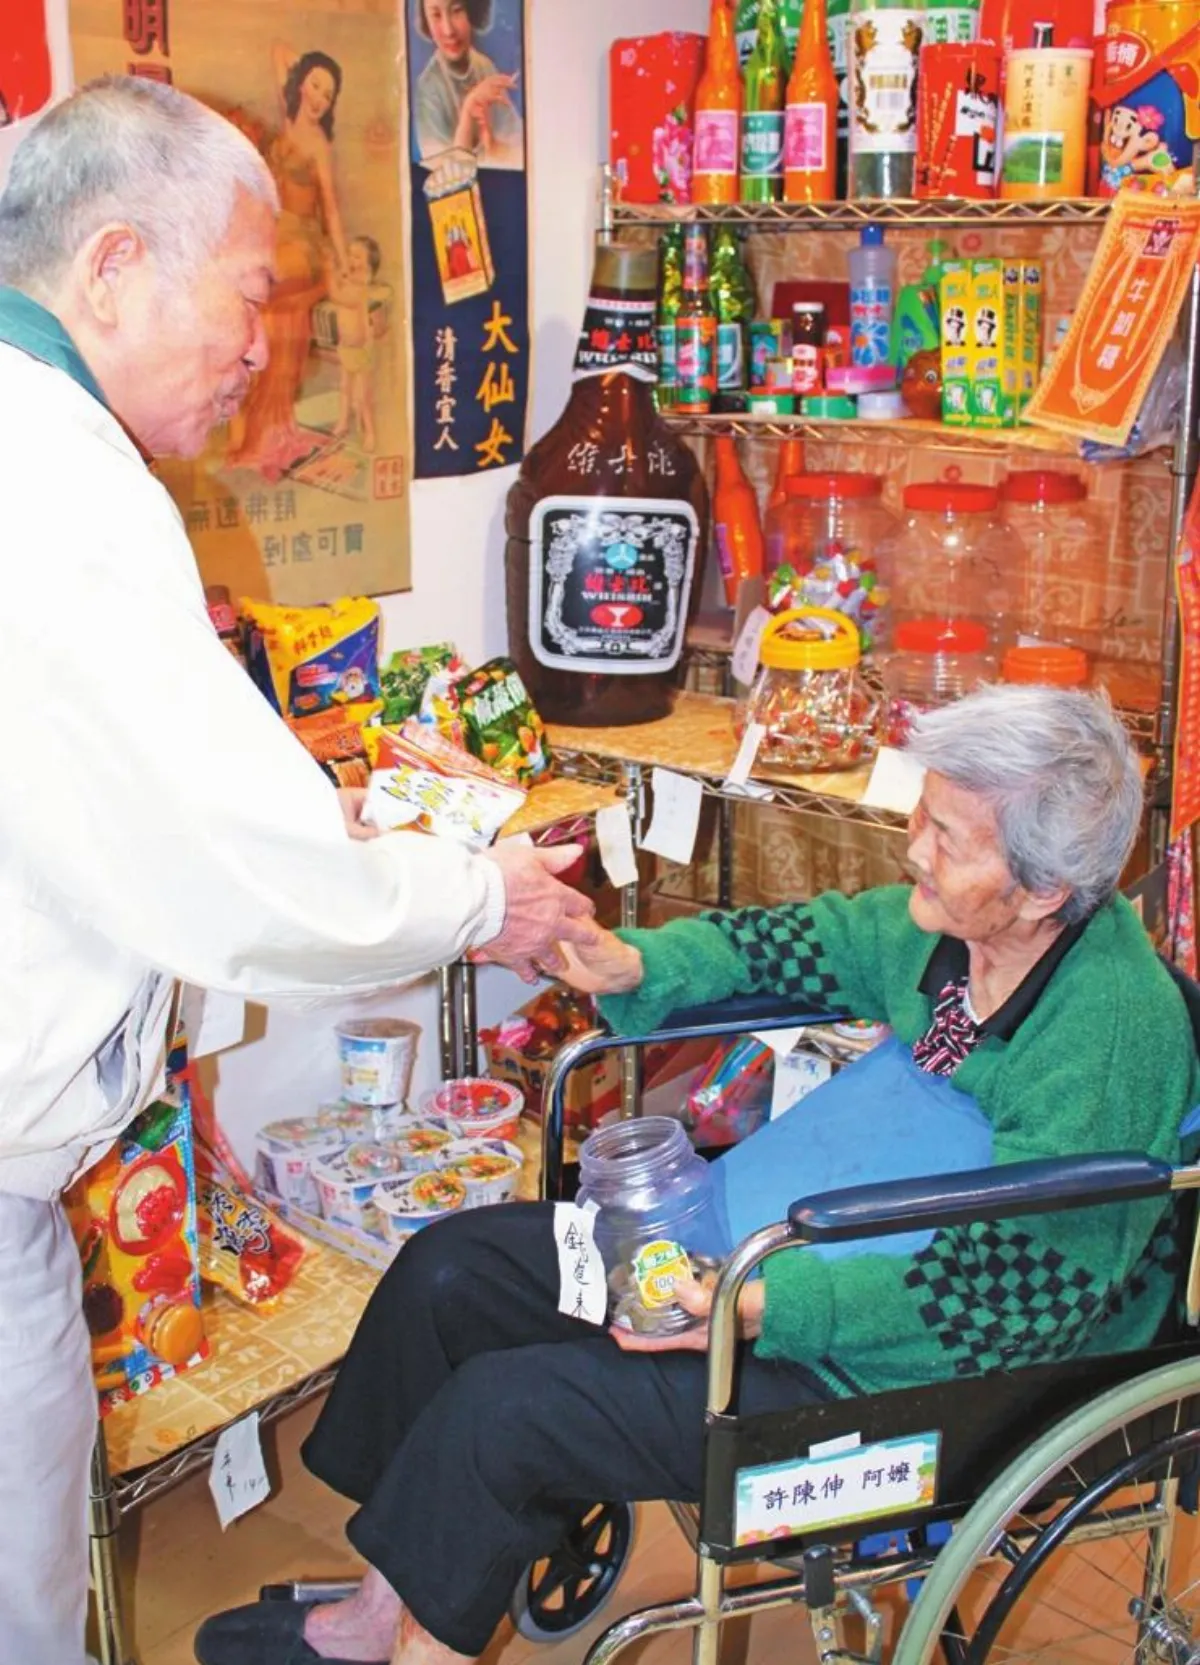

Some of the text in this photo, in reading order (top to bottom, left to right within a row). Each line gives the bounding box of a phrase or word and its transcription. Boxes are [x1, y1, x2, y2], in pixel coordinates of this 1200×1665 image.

[432, 325, 460, 453] 清香宜人
[474, 299, 519, 467] 大仙女
[762, 1461, 913, 1511] 許陳伸 阿嬤
